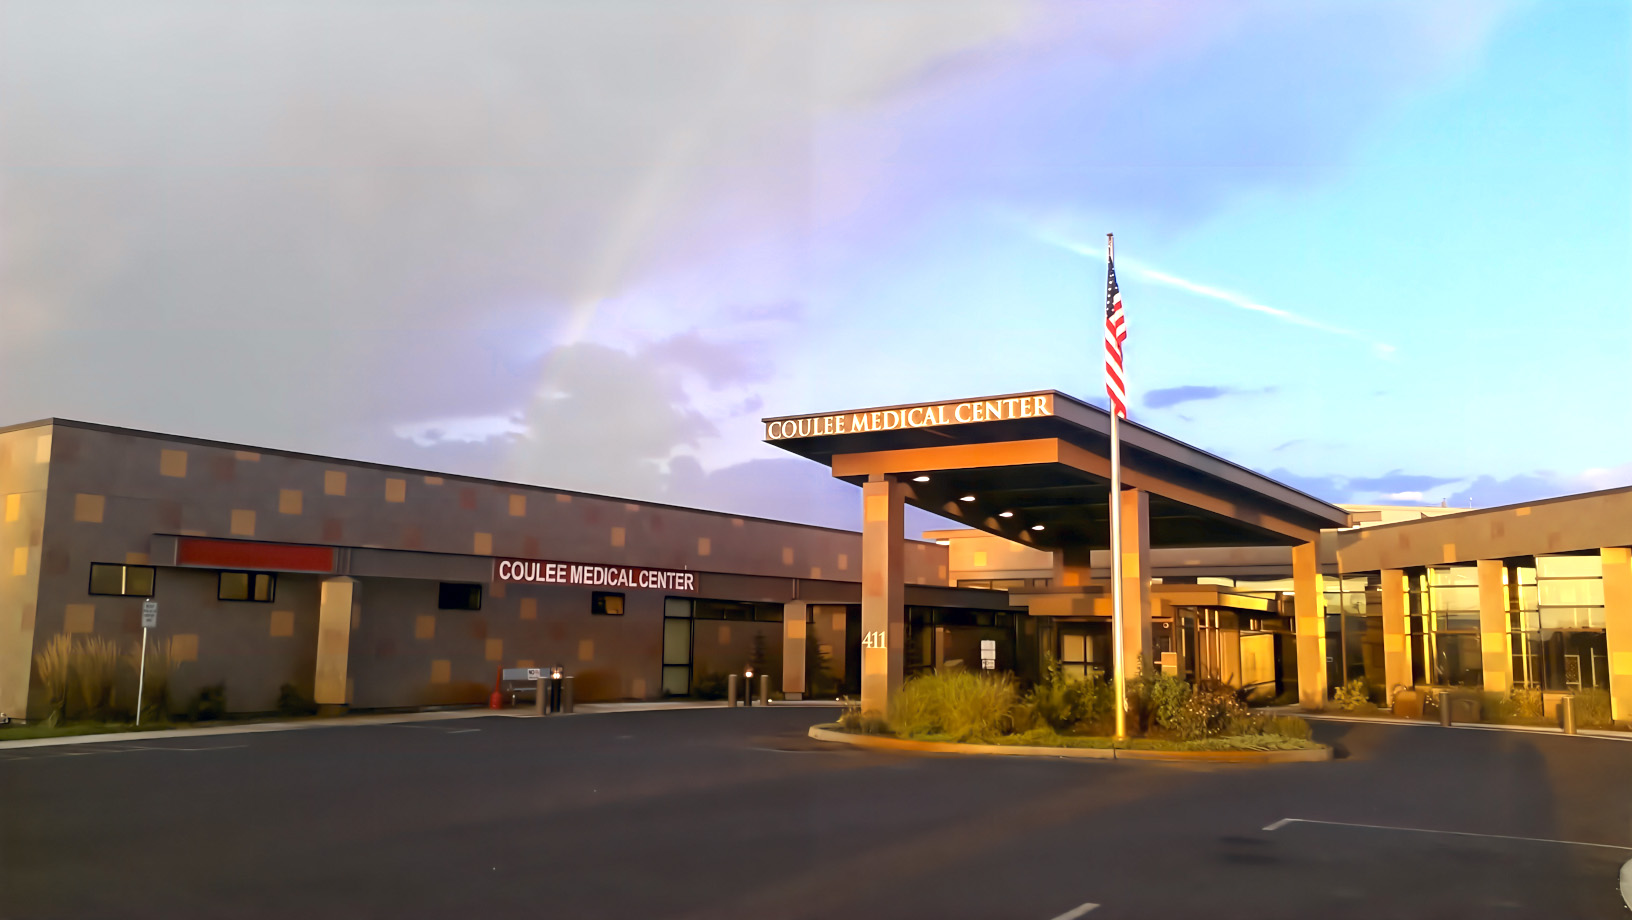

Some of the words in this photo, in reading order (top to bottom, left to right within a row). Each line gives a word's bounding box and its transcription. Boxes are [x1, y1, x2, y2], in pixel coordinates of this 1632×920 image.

[767, 415, 845, 440] COULEE
[850, 406, 949, 432] MEDICAL
[954, 395, 1051, 423] CENTER
[499, 560, 567, 583] COULEE
[570, 565, 637, 587] MEDICAL
[638, 570, 694, 590] CENTER
[862, 631, 886, 648] 411
